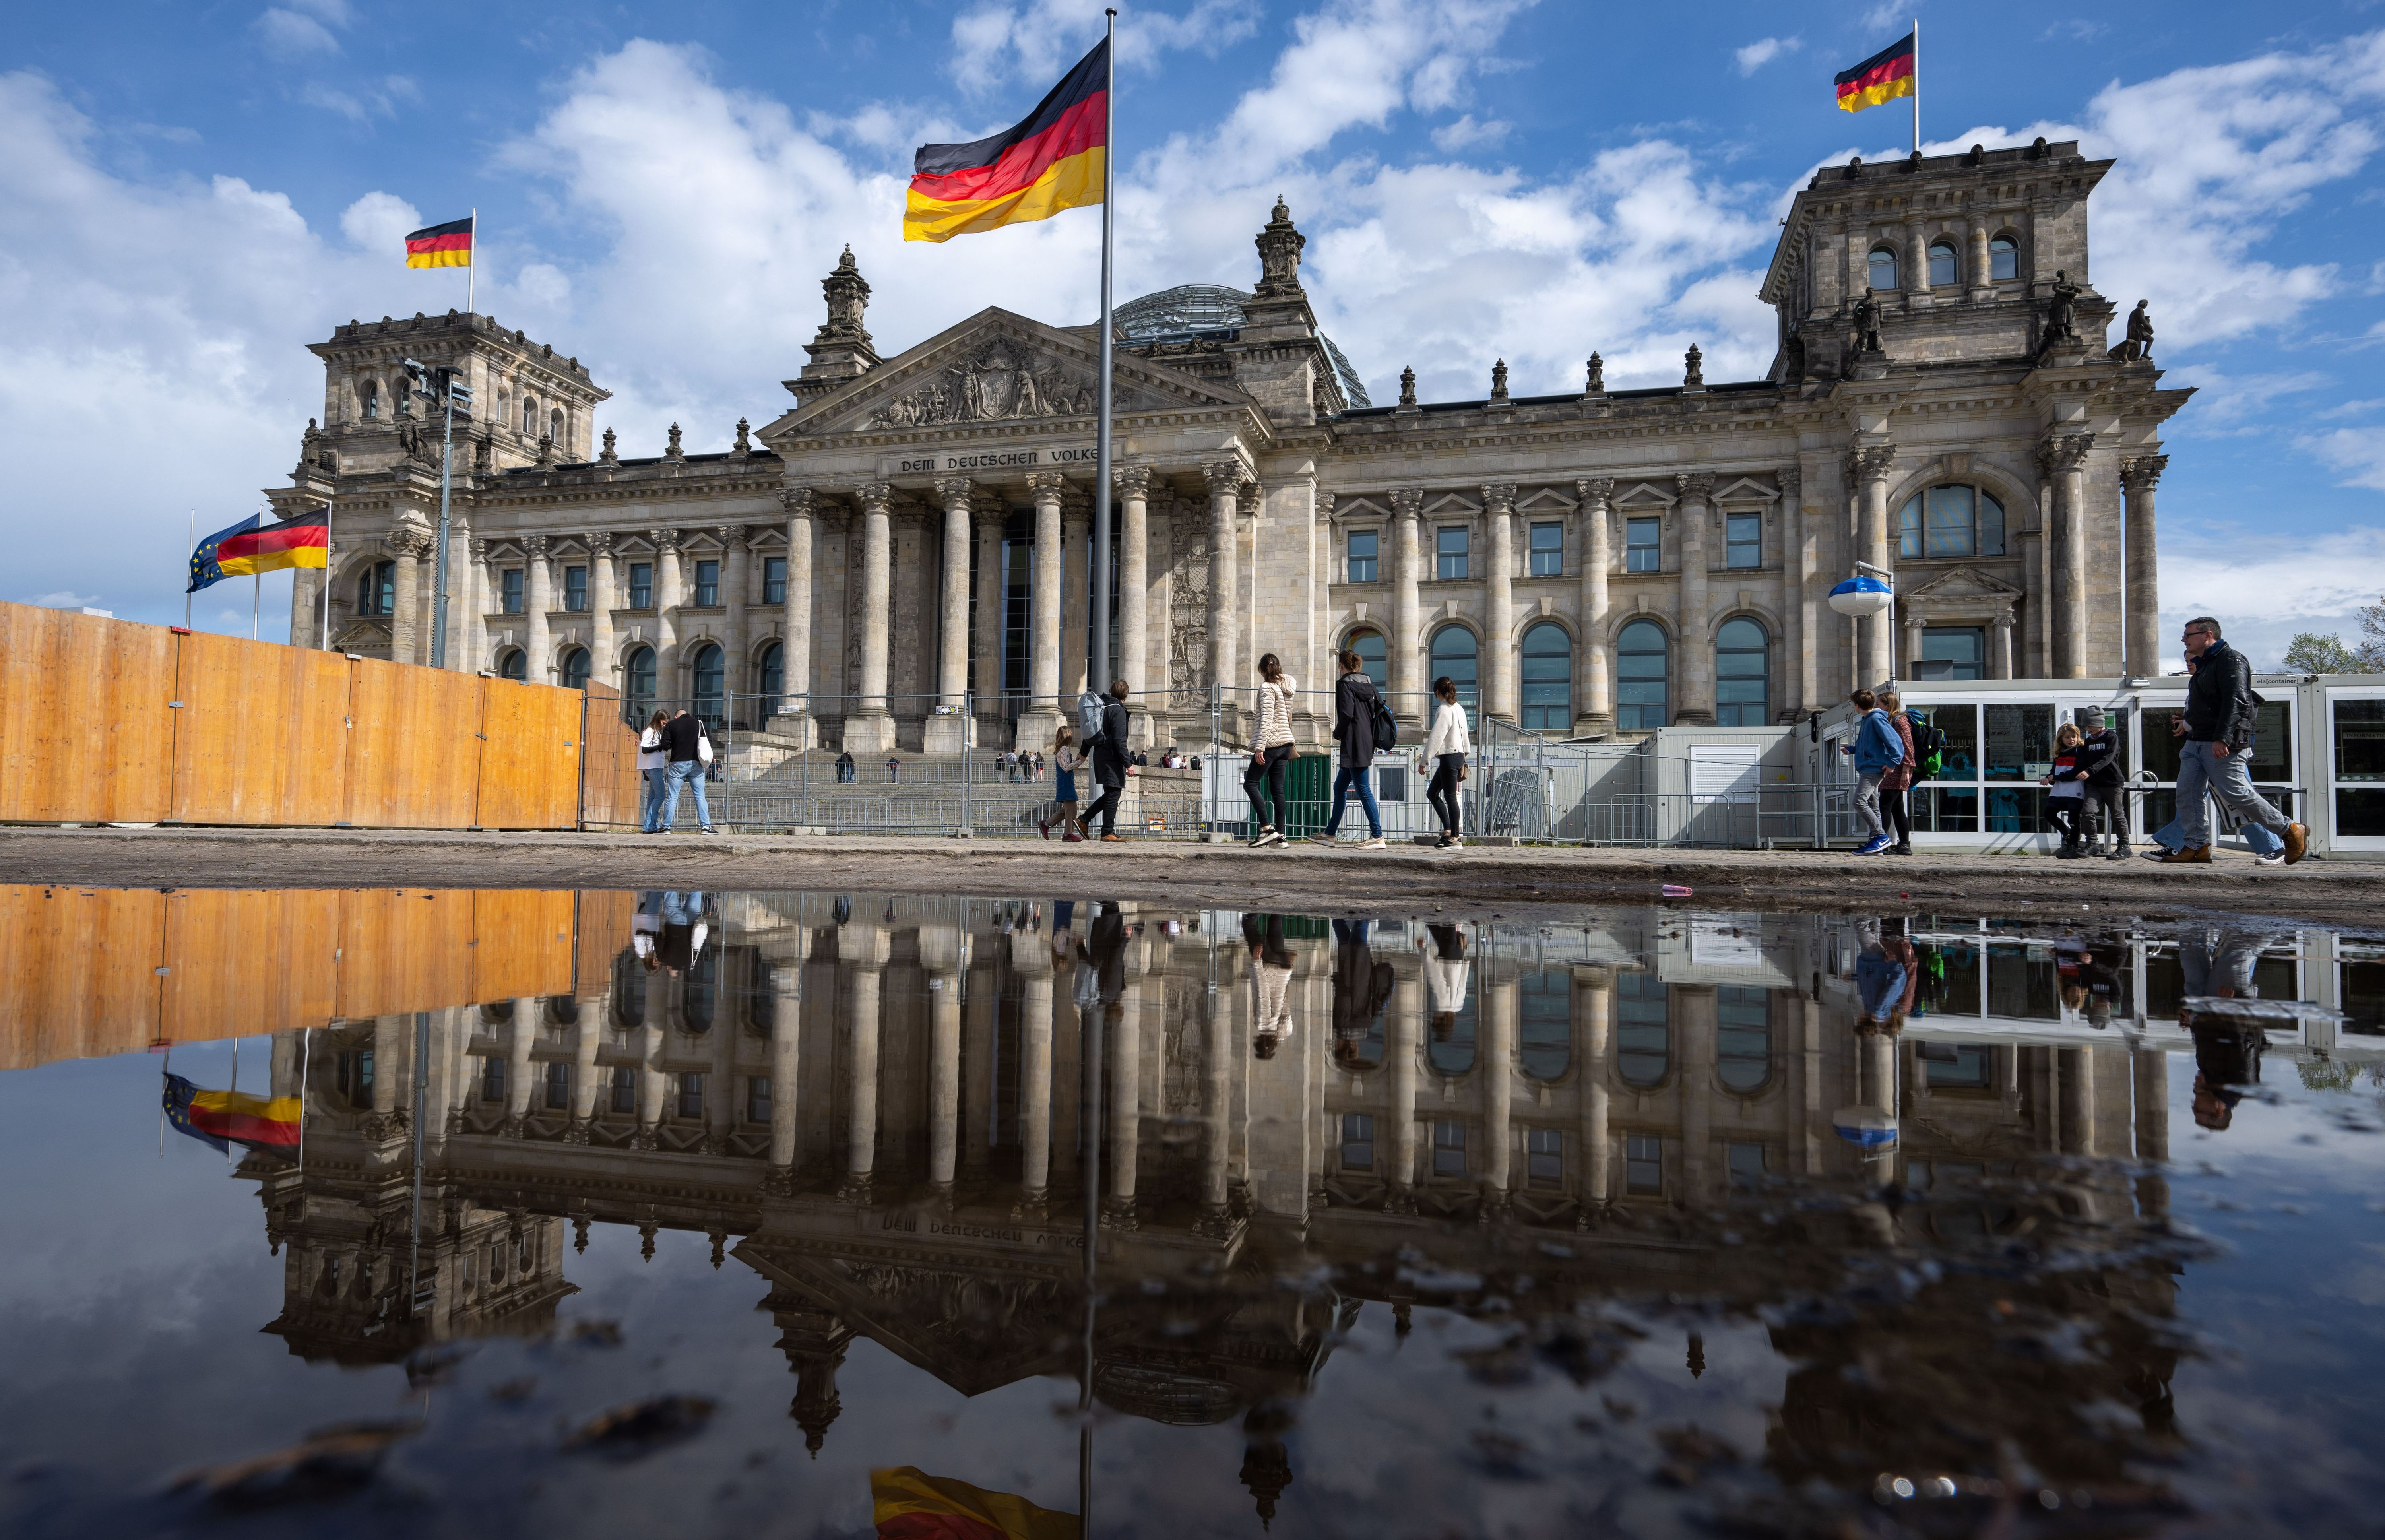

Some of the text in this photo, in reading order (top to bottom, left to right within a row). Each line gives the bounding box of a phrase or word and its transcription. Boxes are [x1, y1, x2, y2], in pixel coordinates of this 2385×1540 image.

[901, 449, 1098, 471] DEM DEUTSCHEN VOLKE
[2089, 743, 2105, 751] PUMA
